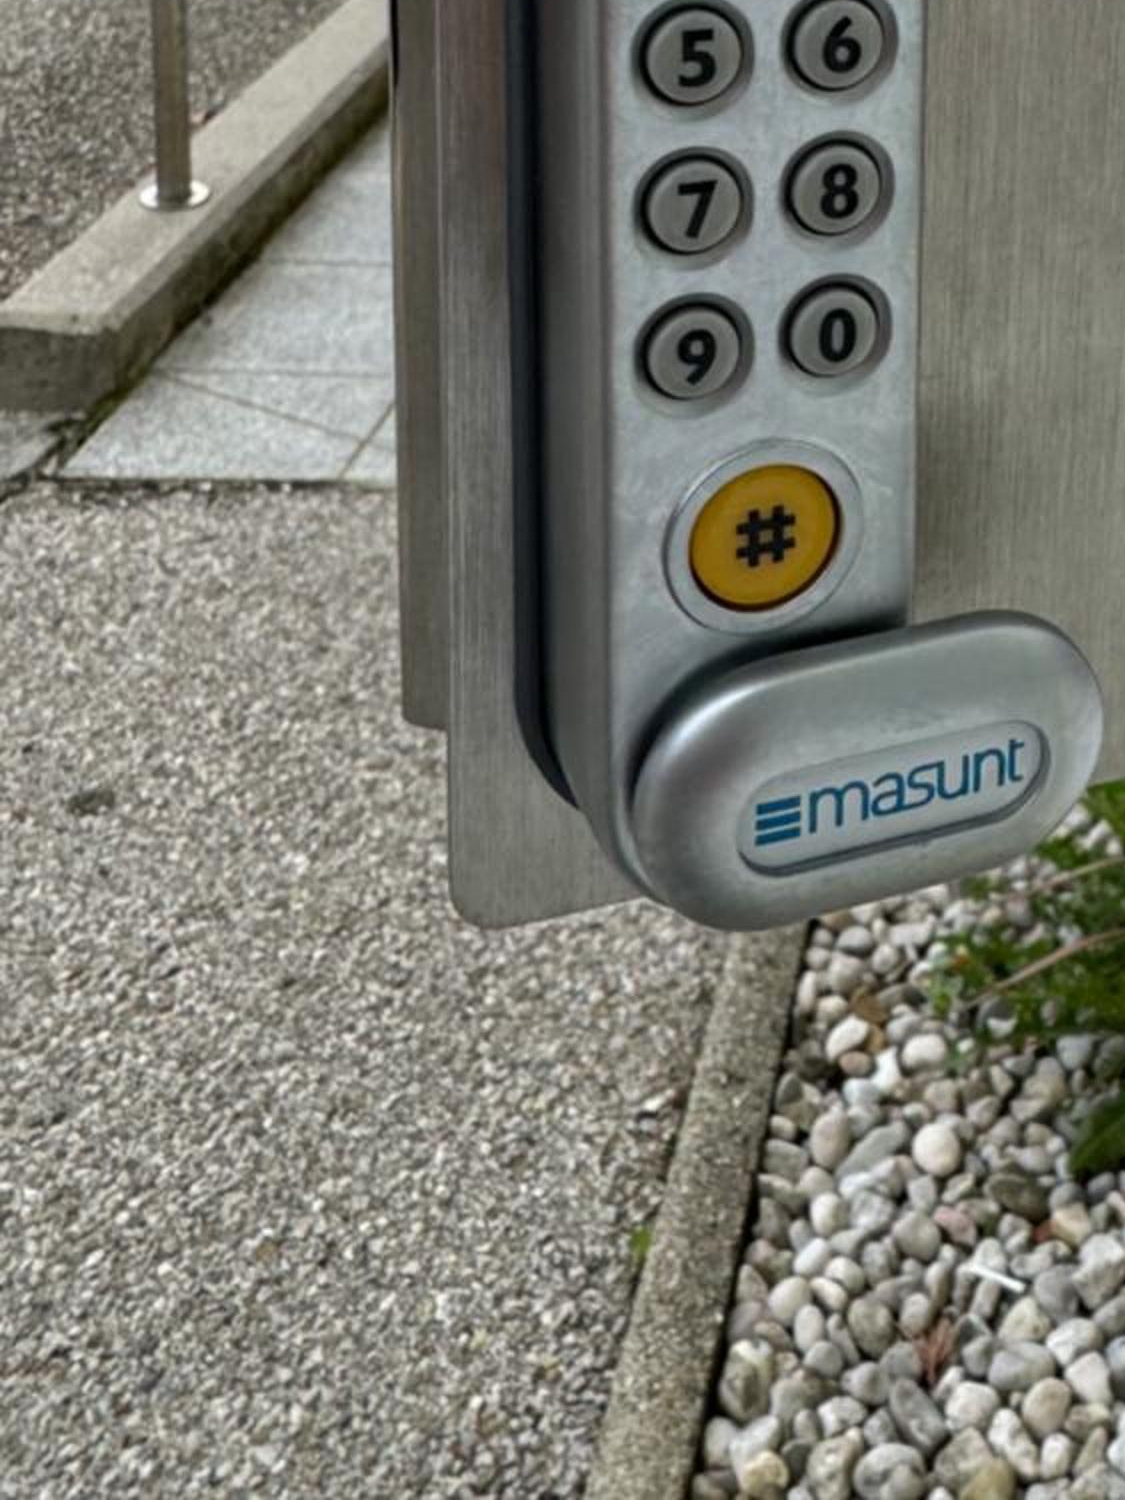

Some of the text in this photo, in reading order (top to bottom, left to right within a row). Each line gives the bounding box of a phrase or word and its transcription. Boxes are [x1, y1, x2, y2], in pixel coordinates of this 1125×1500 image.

[677, 27, 717, 88] 5
[822, 15, 862, 74] 6
[677, 179, 719, 239] 7
[819, 163, 860, 219] 8
[676, 328, 717, 386] 9
[818, 307, 857, 363] 0
[735, 505, 796, 568] #
